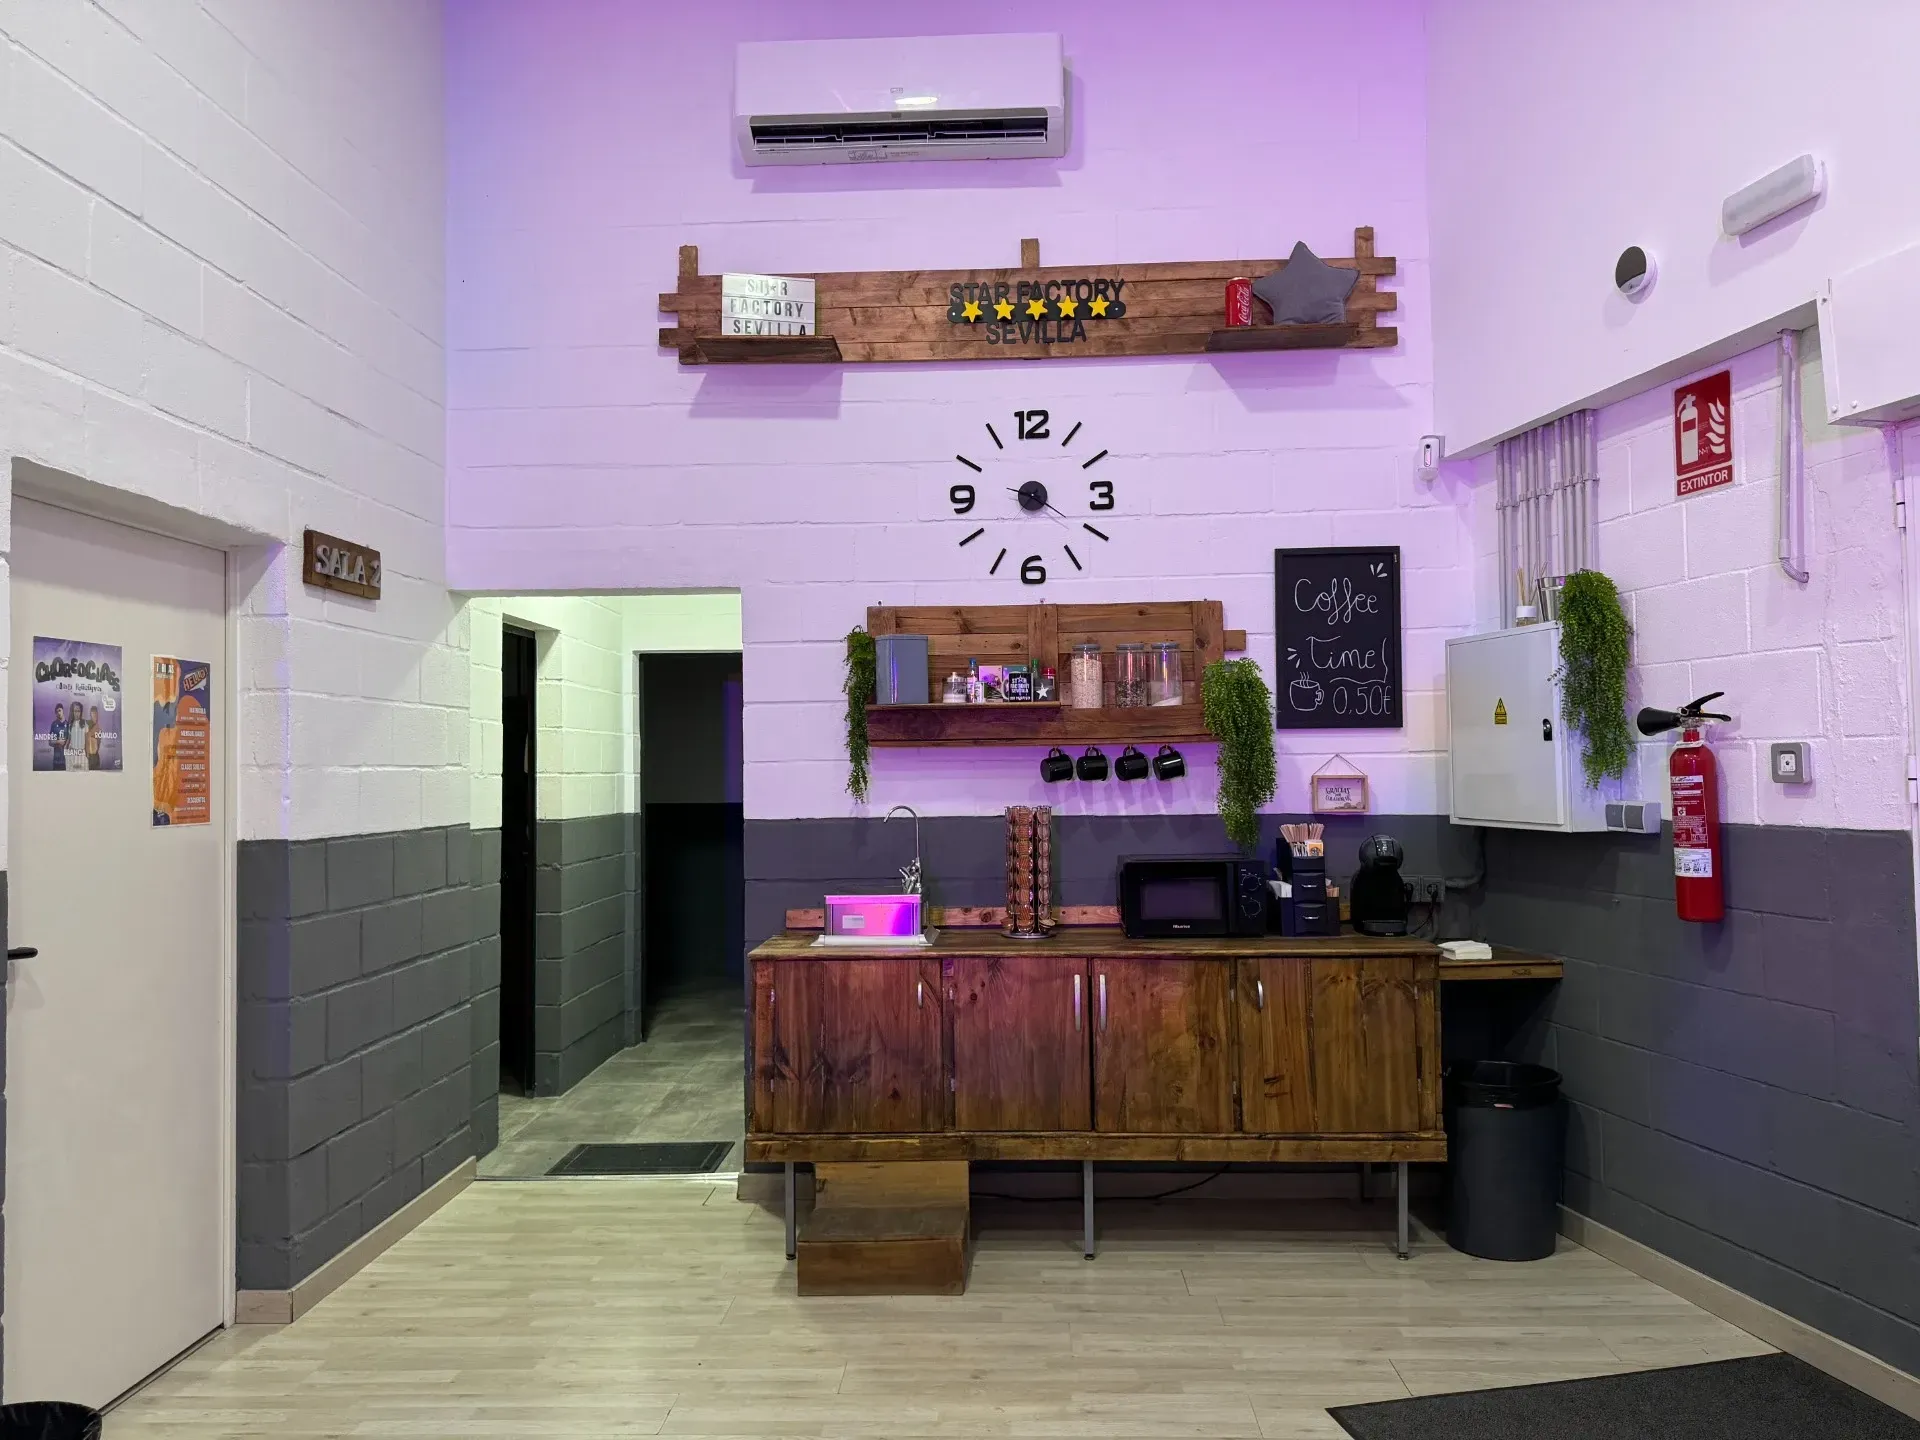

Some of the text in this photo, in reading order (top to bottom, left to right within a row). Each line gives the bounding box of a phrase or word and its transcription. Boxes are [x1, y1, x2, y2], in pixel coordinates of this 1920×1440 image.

[950, 278, 1125, 304] STAR FACTORY
[730, 298, 804, 318] FACTORY
[733, 319, 807, 336] SEVILLA
[985, 316, 1087, 345] SEVILLA
[1013, 409, 1050, 440] 12
[1089, 480, 1115, 510] 3
[1680, 469, 1729, 492] EXTINTOR
[949, 484, 976, 514] 9
[314, 545, 367, 585] SALA
[1020, 554, 1047, 585] 6
[1294, 577, 1379, 625] Coffee
